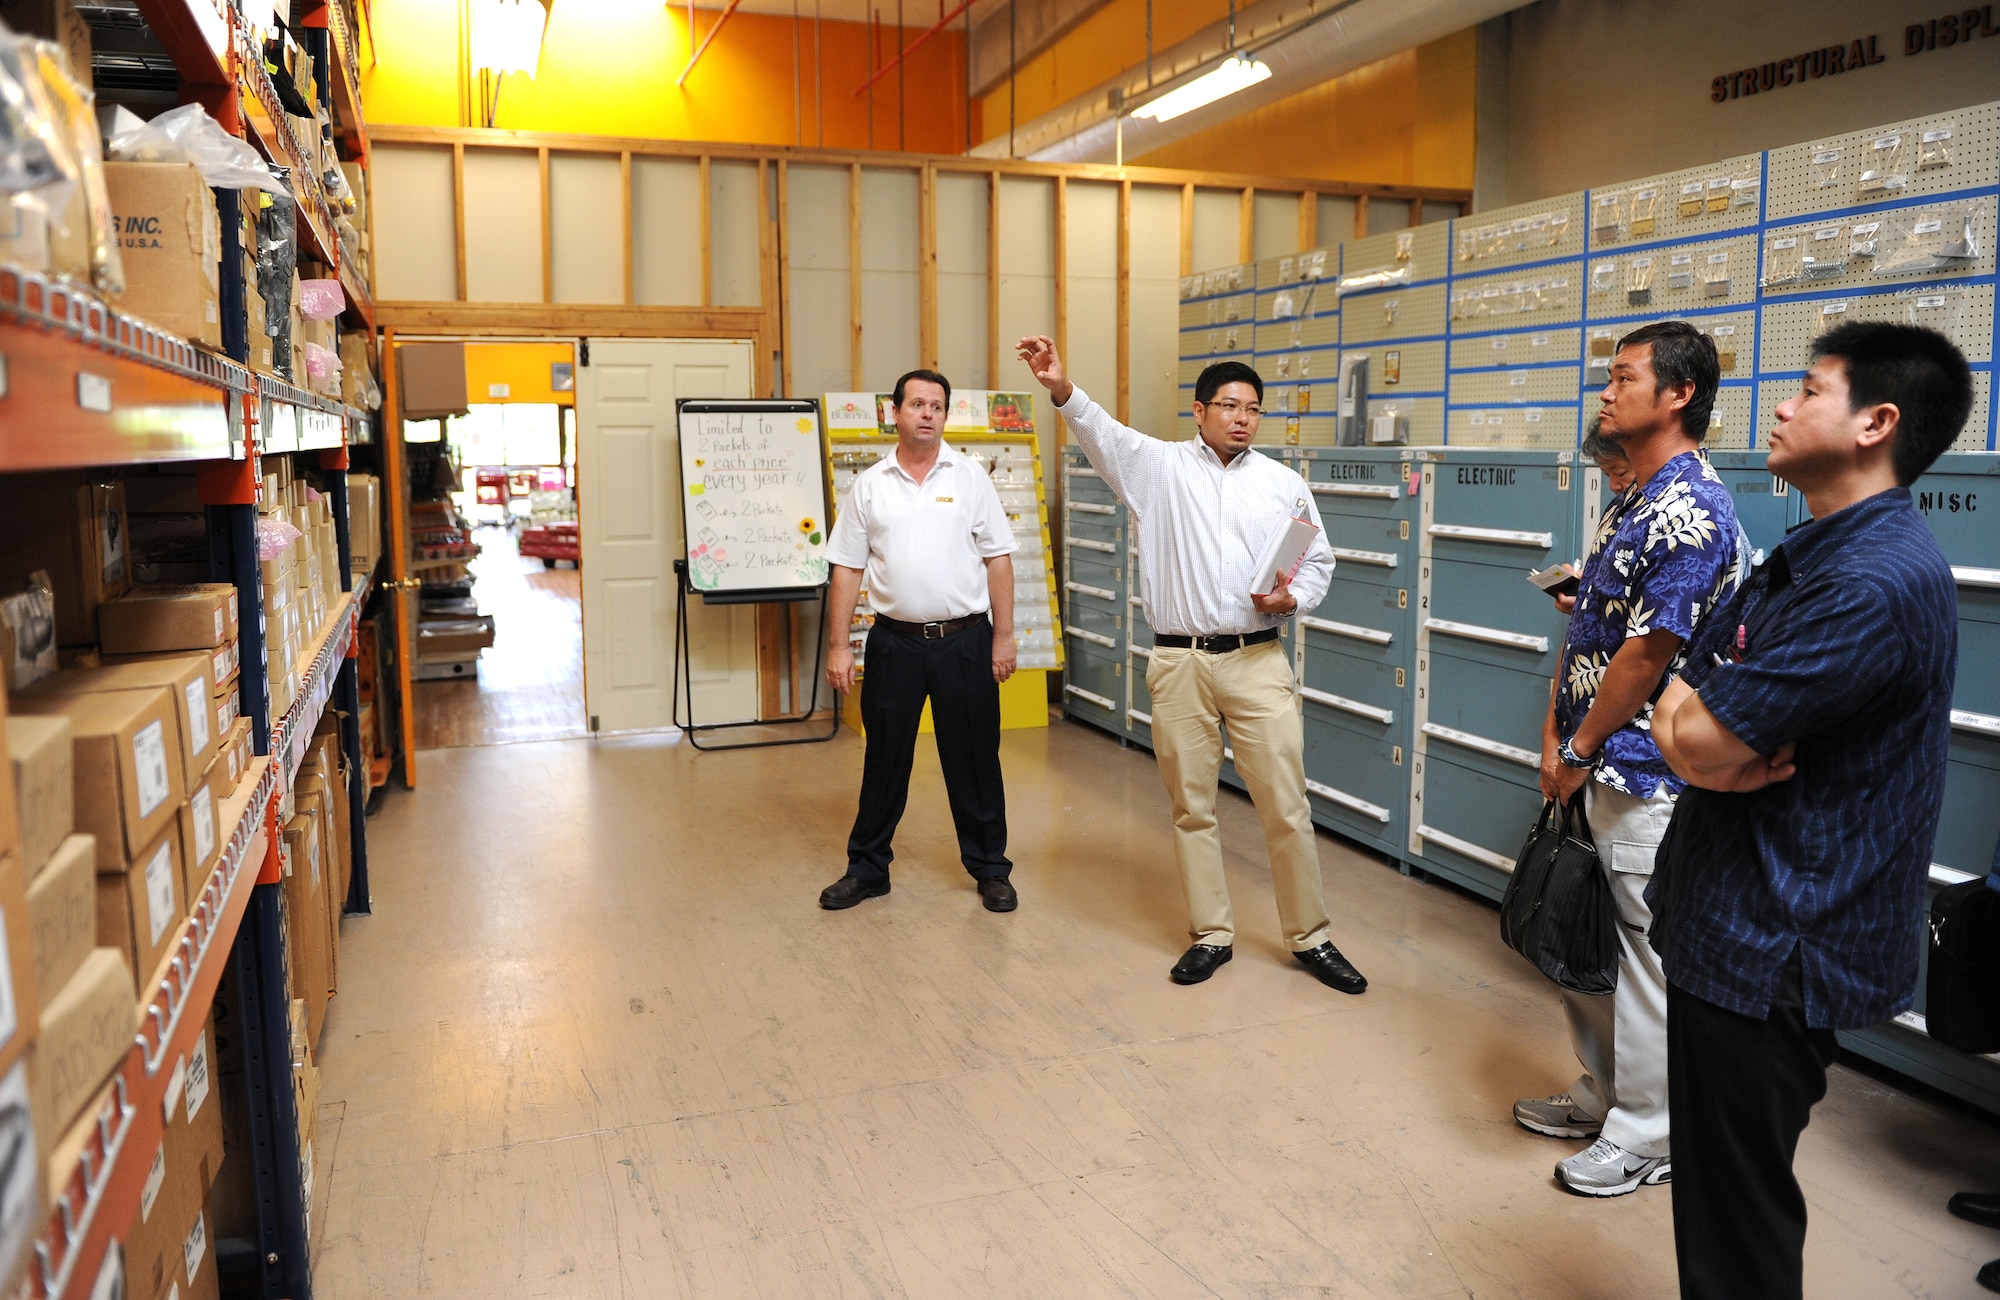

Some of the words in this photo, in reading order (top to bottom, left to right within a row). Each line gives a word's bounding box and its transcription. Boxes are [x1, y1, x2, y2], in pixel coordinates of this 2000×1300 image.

[1711, 35, 1885, 102] STRUCTURAL
[125, 216, 162, 234] INC.
[126, 238, 163, 248] U.S.A.
[832, 410, 871, 420] BURPEE
[698, 414, 744, 435] Limited
[758, 415, 773, 434] to
[698, 437, 709, 452] 2
[713, 436, 751, 452] Packets
[757, 438, 768, 450] of
[713, 453, 746, 469] each
[1331, 464, 1376, 480] ELECTRIC
[1404, 465, 1409, 480] E
[1425, 472, 1431, 484] D
[1458, 467, 1516, 486] ELECTRIC
[1560, 469, 1567, 487] D
[703, 473, 745, 493] every
[754, 472, 790, 491] year
[1591, 478, 1598, 491] D
[741, 499, 751, 516] 2
[752, 501, 783, 518] Packets
[1919, 491, 1977, 514] MISC
[744, 528, 755, 543] 2
[757, 526, 791, 544] Packets
[1401, 522, 1408, 537] D
[745, 552, 757, 568] 2
[1423, 567, 1429, 579] D
[1400, 591, 1406, 606] C
[1422, 597, 1428, 608] 2
[1420, 660, 1426, 671] D
[1397, 670, 1403, 685] B
[1419, 688, 1424, 699] 3
[1394, 748, 1400, 764] A
[1415, 763, 1421, 774] D
[1415, 790, 1421, 802] 4
